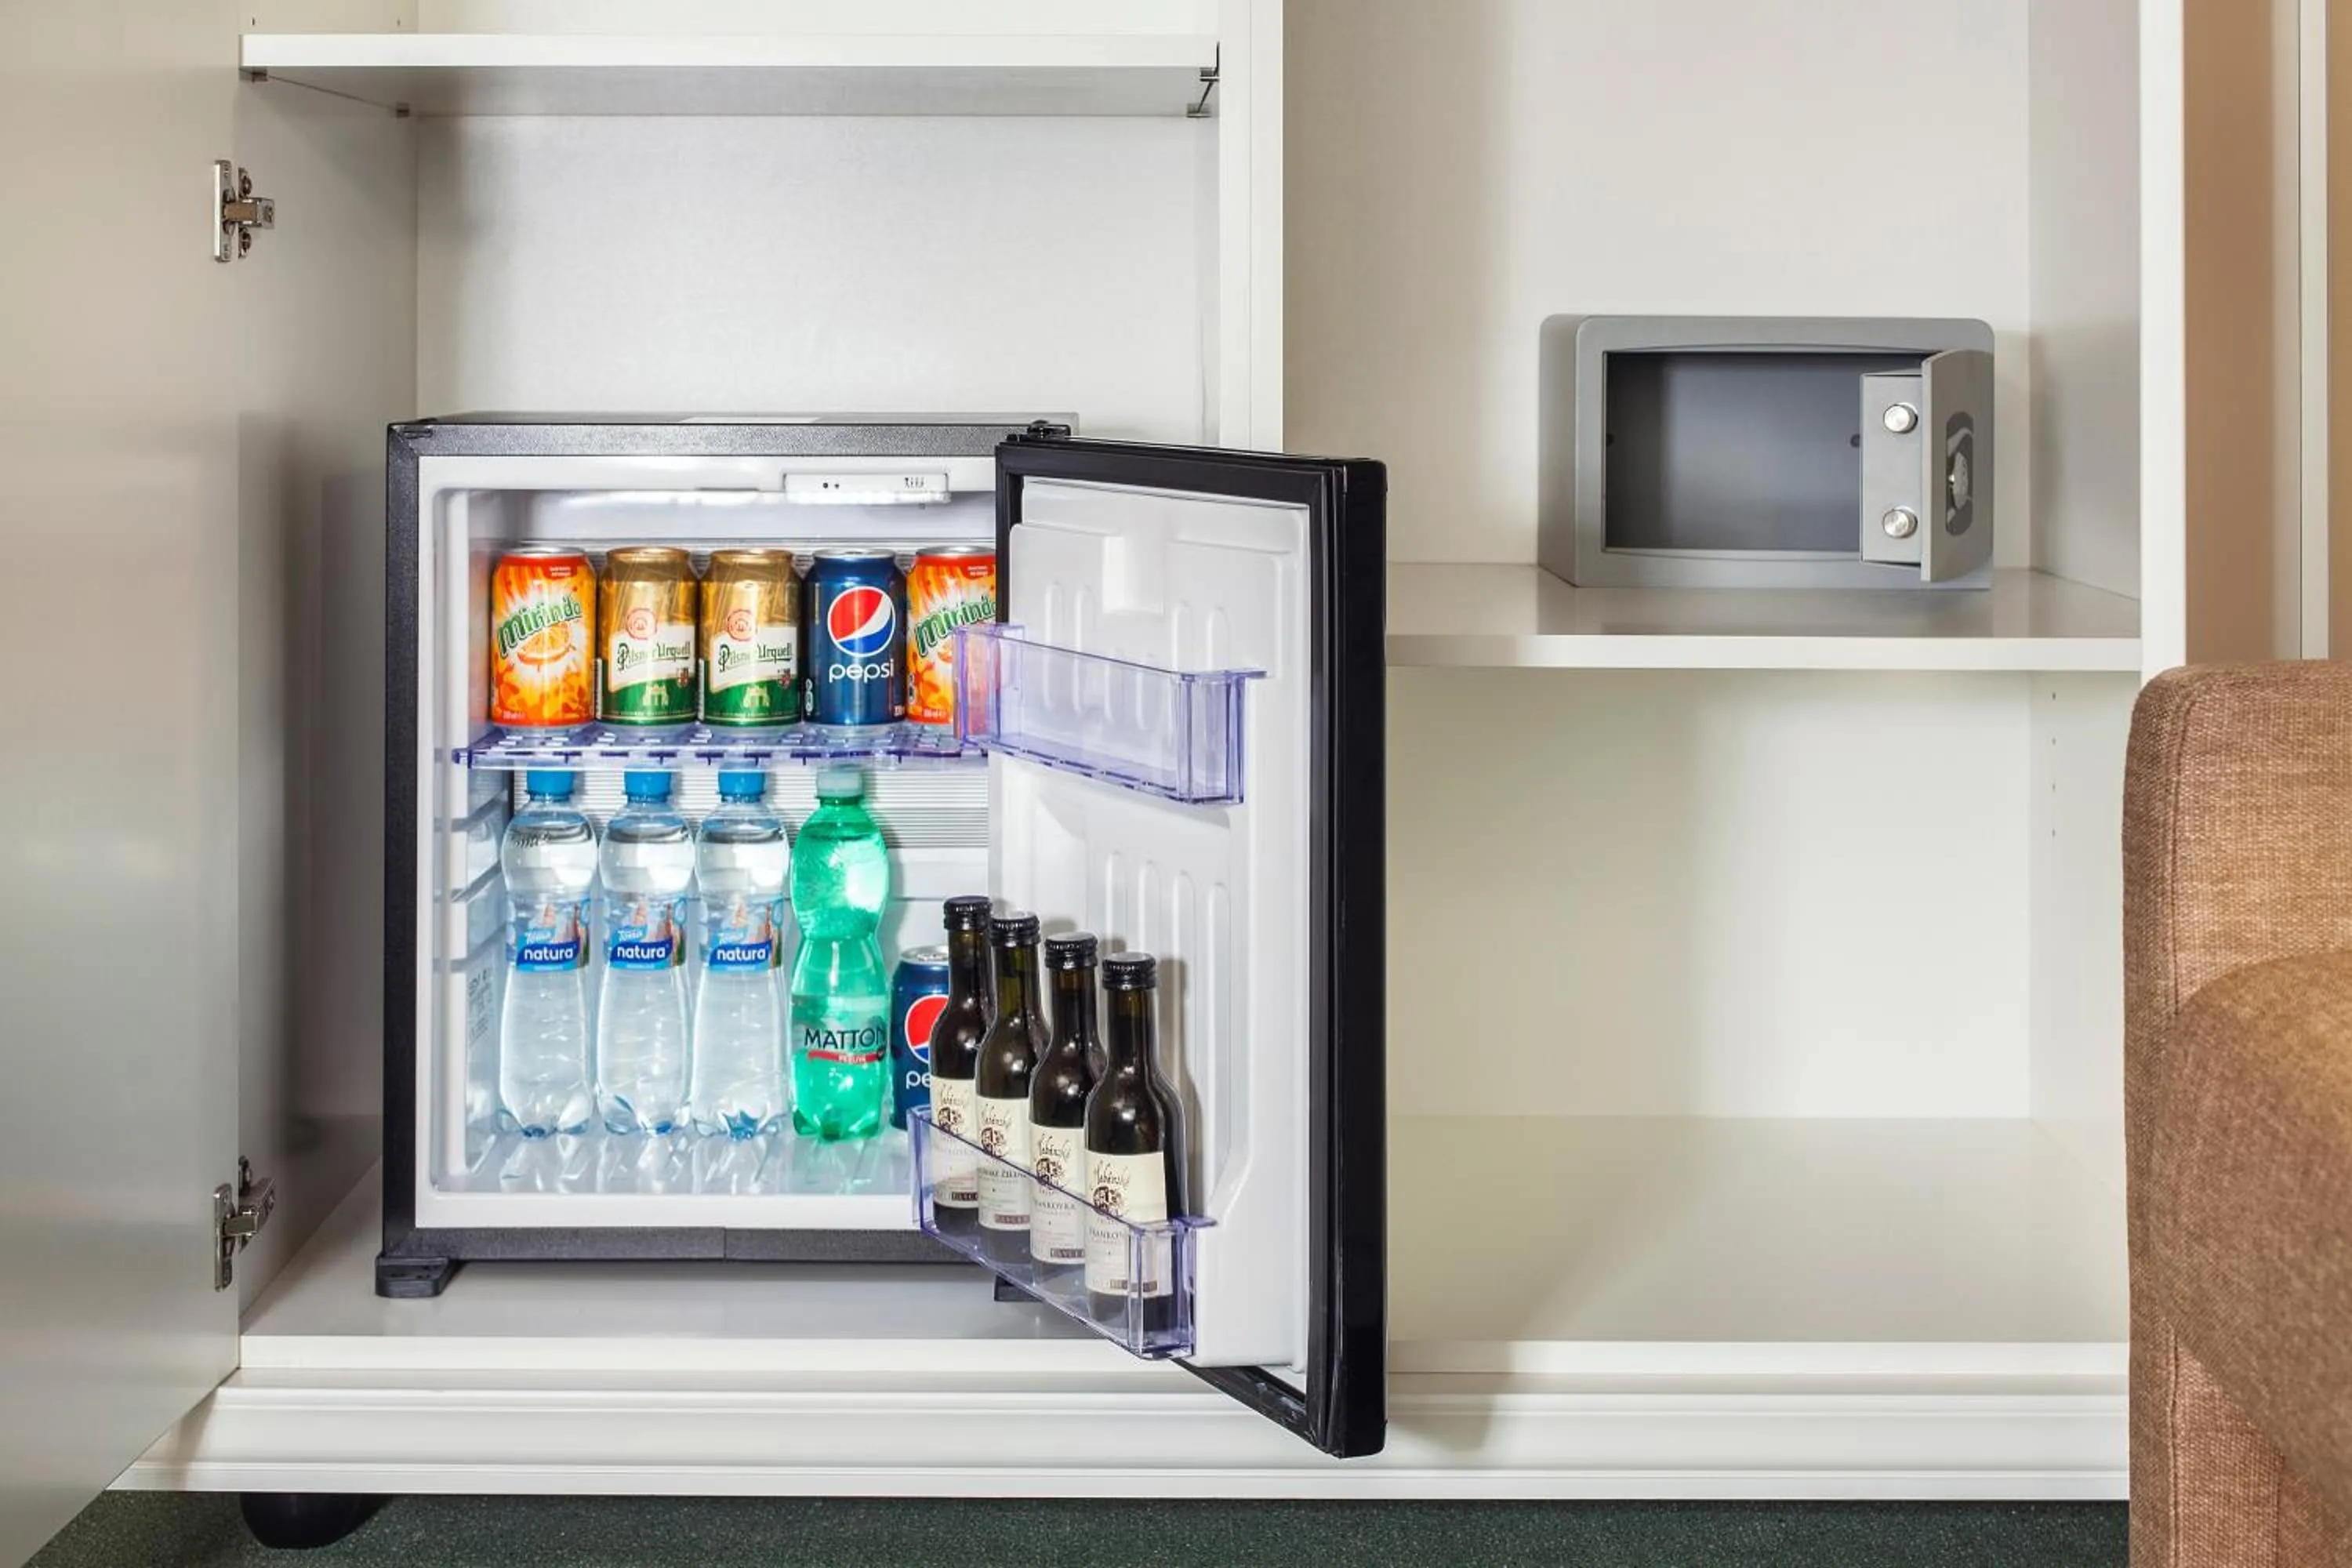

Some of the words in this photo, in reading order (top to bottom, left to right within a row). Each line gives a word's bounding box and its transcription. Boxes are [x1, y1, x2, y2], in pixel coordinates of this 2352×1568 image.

[617, 642, 655, 671] Pilsnr
[829, 658, 895, 684] pepsi
[524, 946, 574, 961] natura
[617, 945, 666, 960] natura
[717, 946, 767, 962] natura
[906, 1070, 931, 1090] pe
